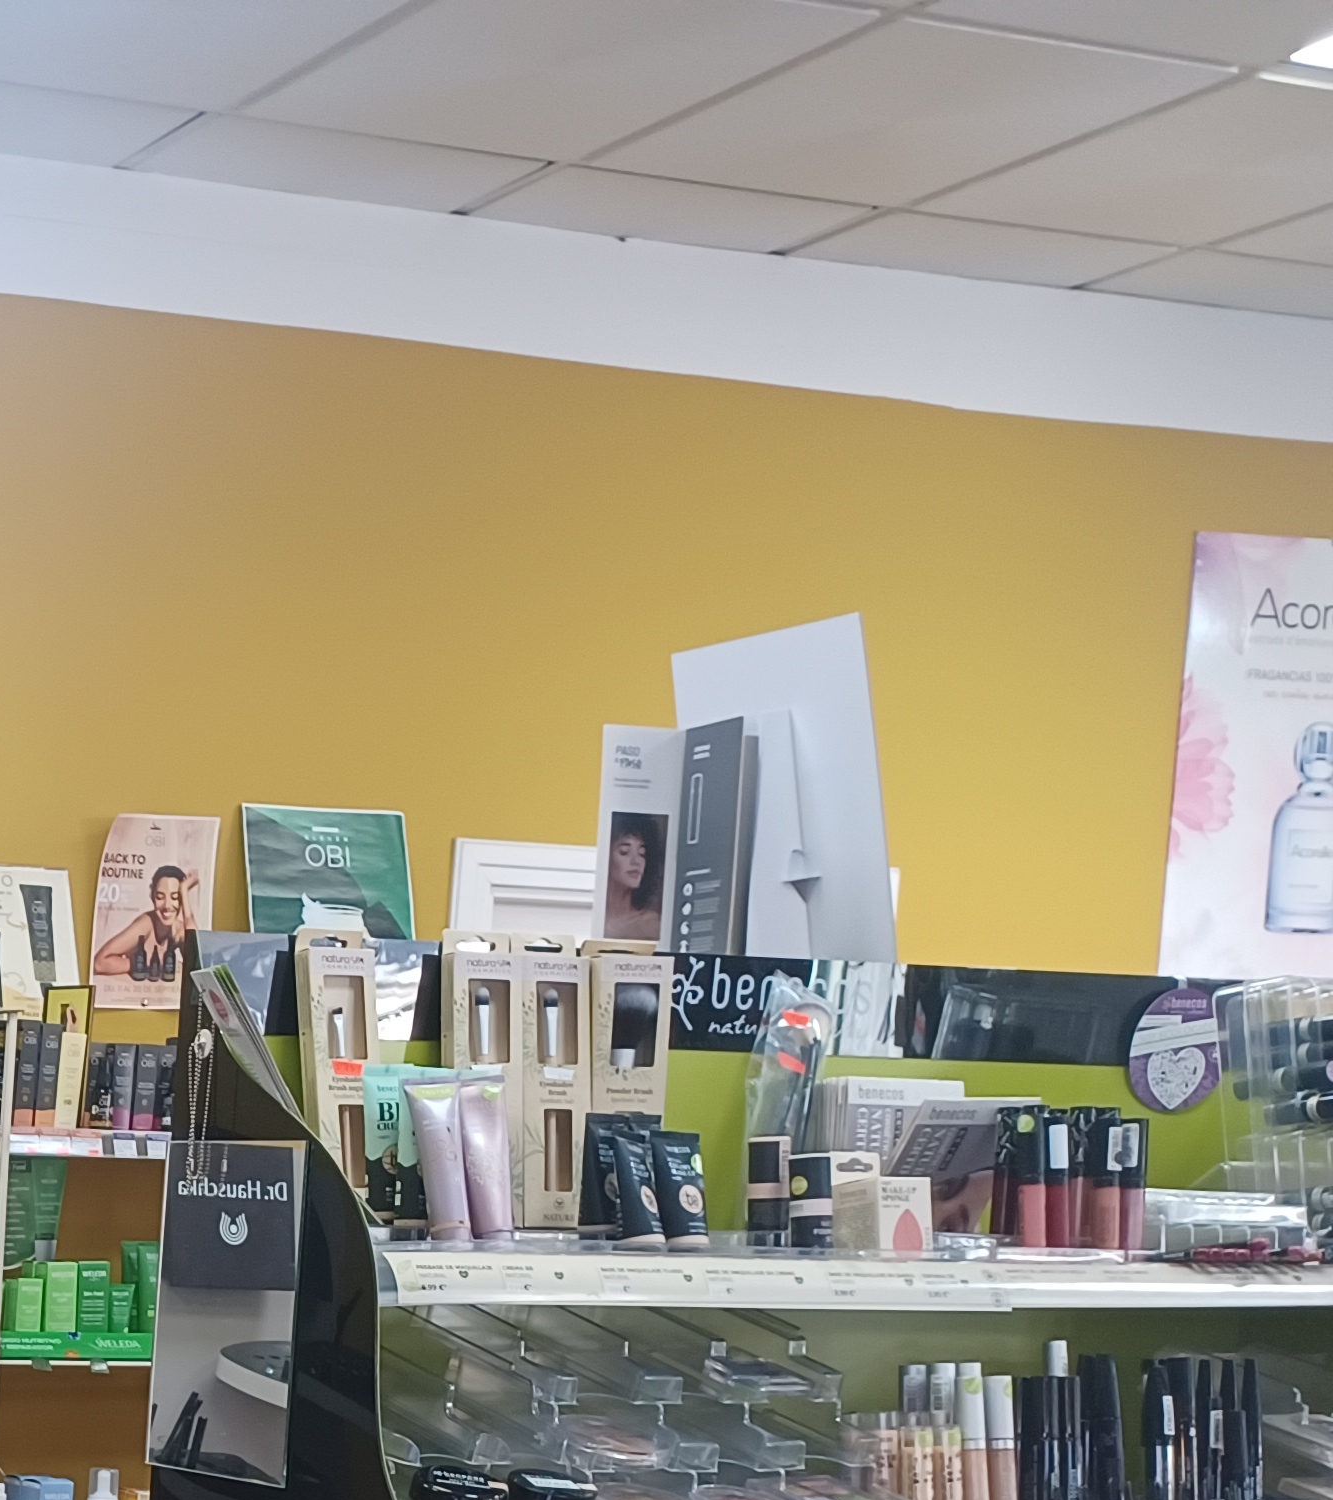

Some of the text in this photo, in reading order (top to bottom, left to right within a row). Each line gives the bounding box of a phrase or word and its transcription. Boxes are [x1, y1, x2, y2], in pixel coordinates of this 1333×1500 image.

[145, 835, 165, 847] OBI
[104, 853, 146, 865] BACK TO
[305, 845, 351, 868] OBI
[102, 867, 143, 879] ROUTINE
[100, 883, 119, 902] 20
[95, 1337, 139, 1349] WELEDA
